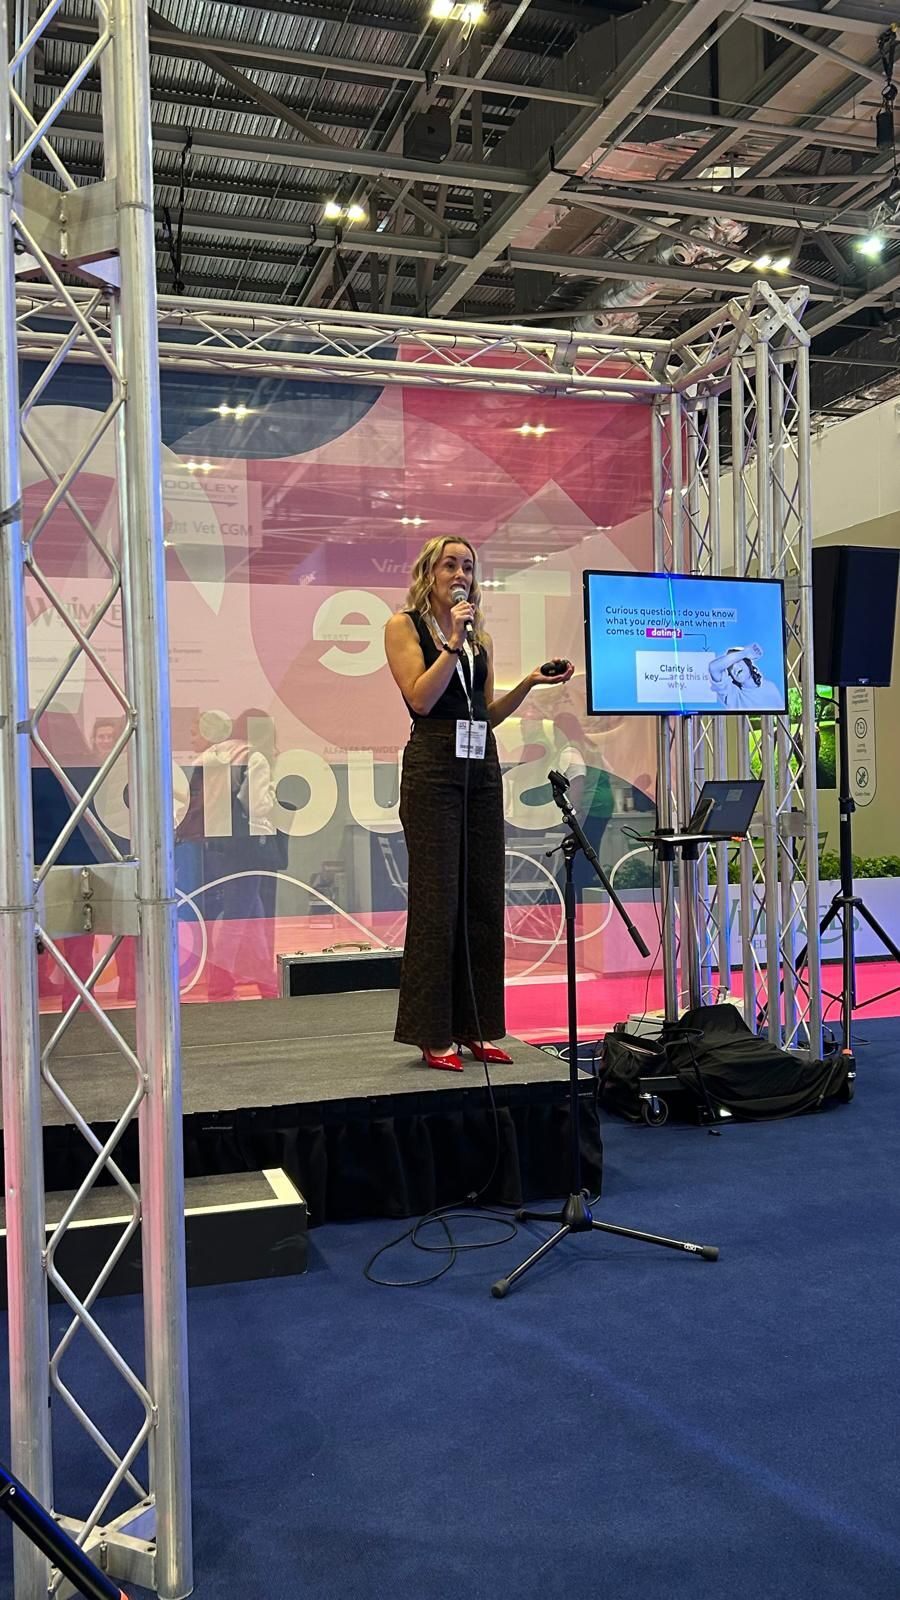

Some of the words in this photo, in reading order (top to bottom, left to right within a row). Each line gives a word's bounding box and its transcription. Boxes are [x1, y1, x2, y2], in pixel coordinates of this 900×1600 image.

[165, 480, 239, 493] OODLEY
[192, 521, 216, 535] Vet
[221, 523, 253, 537] CGM
[371, 558, 412, 575] Virb
[605, 606, 638, 616] Curious
[640, 608, 677, 619] question
[682, 609, 693, 617] do
[695, 611, 710, 619] you
[712, 610, 735, 618] know
[606, 617, 628, 625] what
[630, 619, 645, 627] you
[647, 618, 671, 628] really
[674, 620, 693, 628] want
[695, 620, 717, 628] when
[719, 620, 726, 628] it
[606, 628, 634, 636] comes
[636, 628, 645, 636] to
[651, 629, 681, 638] dating?
[659, 664, 685, 673] Clarity
[686, 664, 694, 672] is
[686, 673, 701, 681] this
[667, 682, 687, 690] why.
